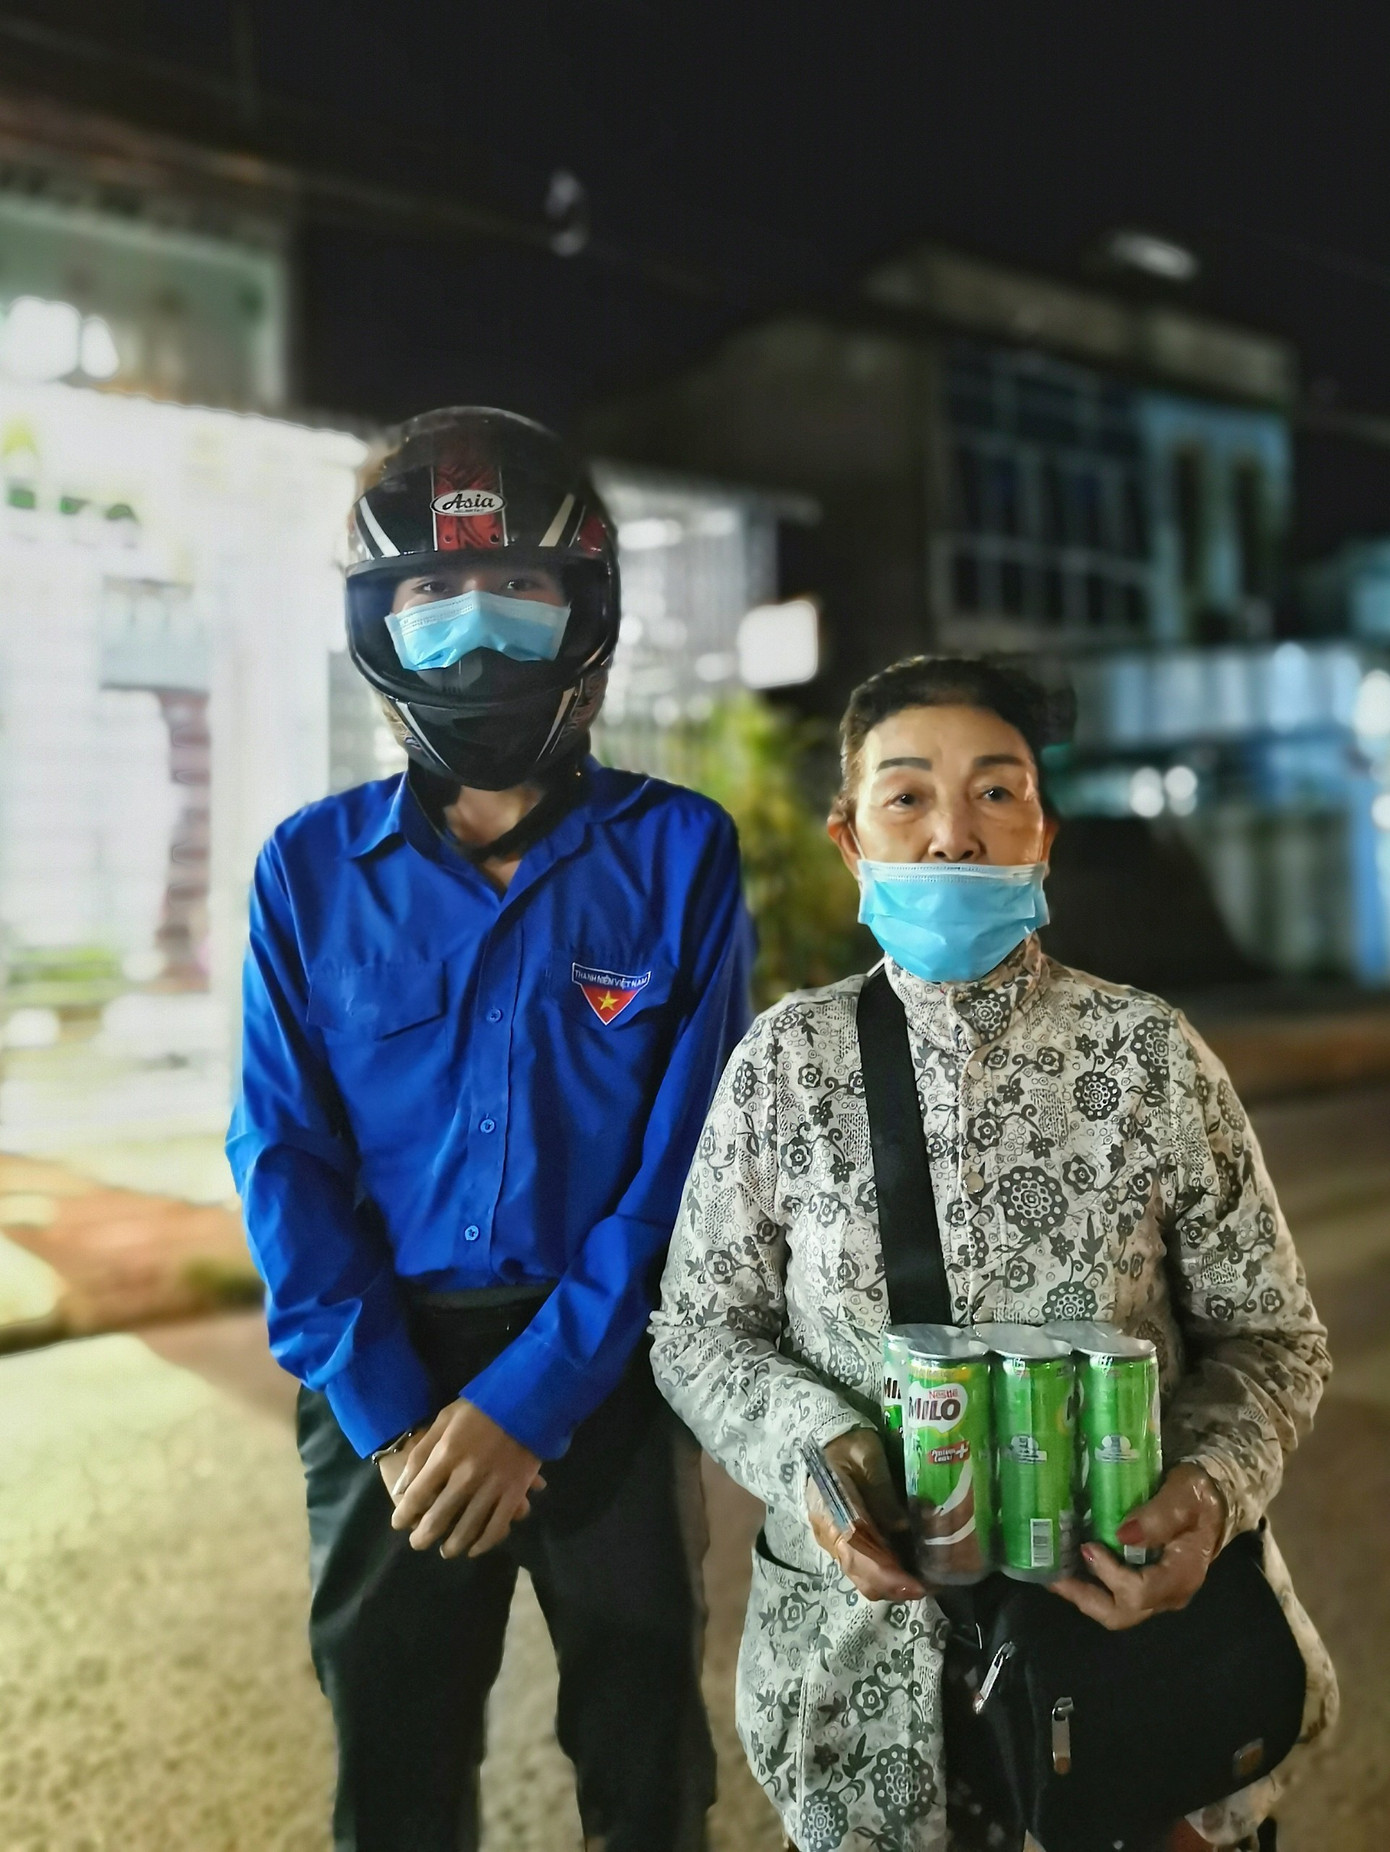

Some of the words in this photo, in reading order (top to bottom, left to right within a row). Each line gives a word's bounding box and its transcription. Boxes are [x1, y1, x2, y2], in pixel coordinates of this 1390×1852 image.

[442, 493, 495, 510] Asia
[575, 970, 596, 982] THANH
[631, 976, 648, 987] NAM
[908, 1396, 961, 1420] MILO
